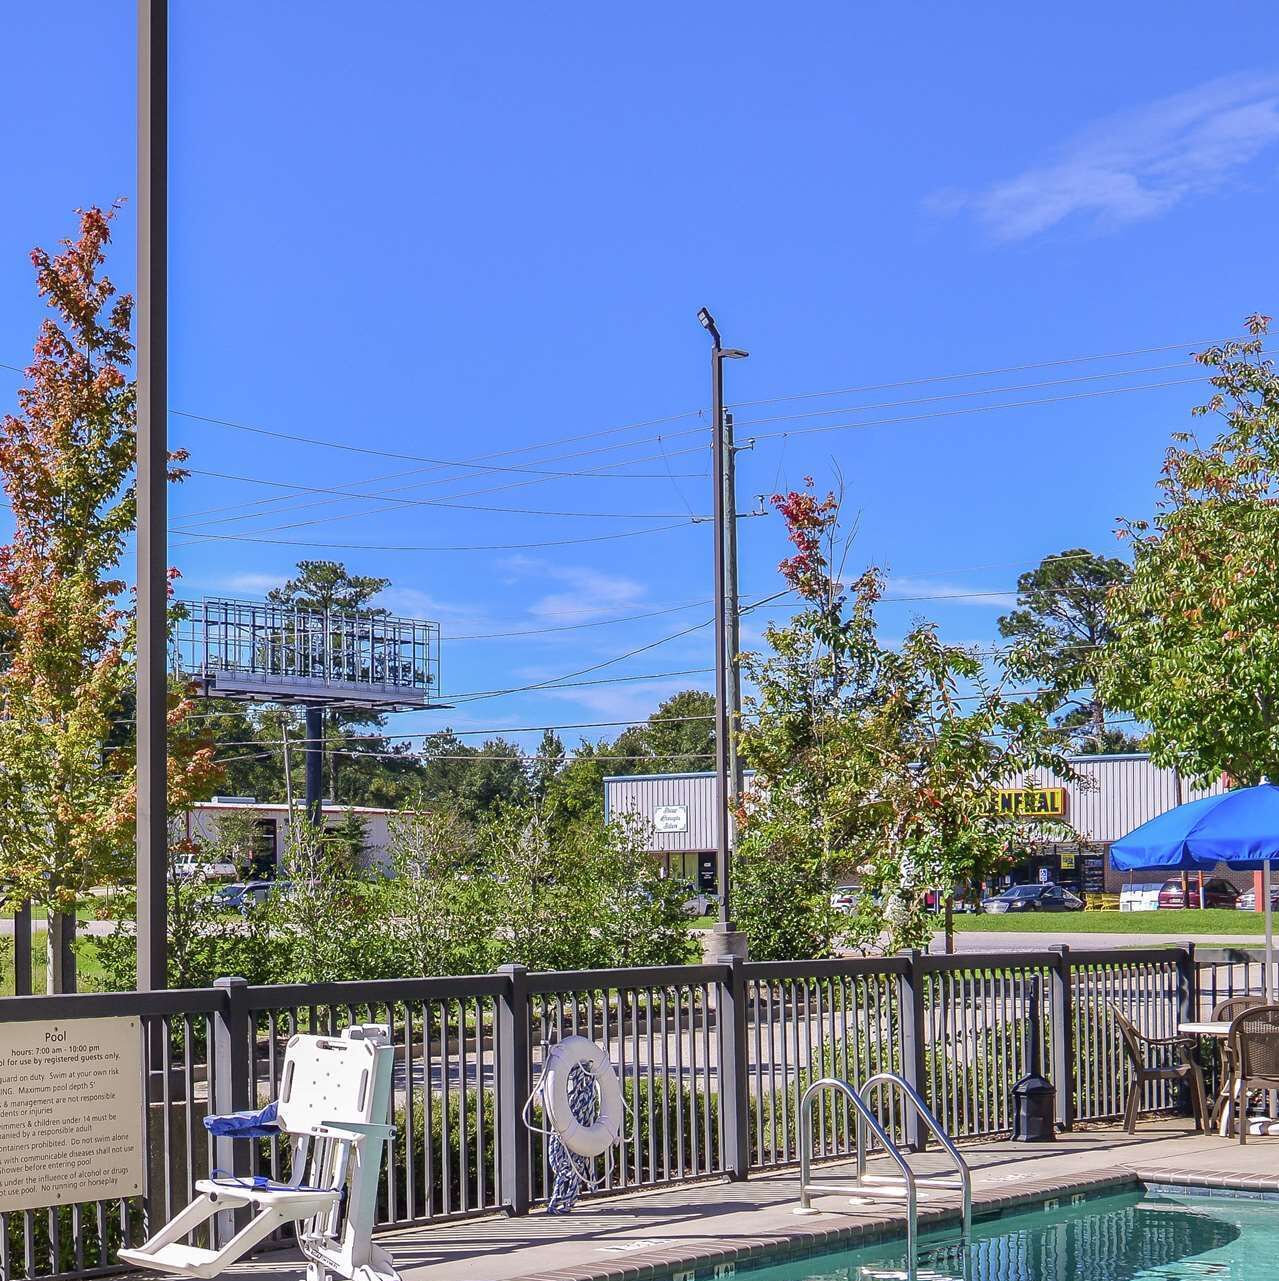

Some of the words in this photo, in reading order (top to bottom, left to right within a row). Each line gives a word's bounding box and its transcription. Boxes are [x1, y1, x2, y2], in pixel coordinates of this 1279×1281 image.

[45, 1031, 66, 1042] Pool
[36, 1047, 50, 1055] 7:00
[69, 1045, 87, 1053] 10:00
[7, 1058, 17, 1066] for
[33, 1057, 42, 1066] by
[44, 1054, 79, 1064] registered
[81, 1054, 103, 1063] guests
[49, 1071, 67, 1080] Swim
[77, 1070, 91, 1079] your
[18, 1086, 51, 1094] Maximum
[53, 1083, 67, 1092] pool
[68, 1082, 88, 1091] depth
[10, 1098, 53, 1108] management
[80, 1092, 115, 1102] responsible
[34, 1118, 60, 1127] children
[61, 1116, 80, 1124] under
[22, 1130, 31, 1139] by
[37, 1127, 74, 1137] responsible
[94, 1135, 110, 1143] swim
[4, 1156, 19, 1164] with
[20, 1151, 68, 1163] communicable
[68, 1150, 94, 1158] diseases
[96, 1146, 110, 1155] shall
[24, 1163, 46, 1172] before
[48, 1160, 76, 1169] entering
[4, 1178, 23, 1187] under
[25, 1176, 37, 1184] the
[38, 1174, 68, 1183] influence
[69, 1171, 76, 1179] of
[78, 1168, 101, 1178] alcohol
[41, 1184, 50, 1192] No
[52, 1182, 78, 1190] running
